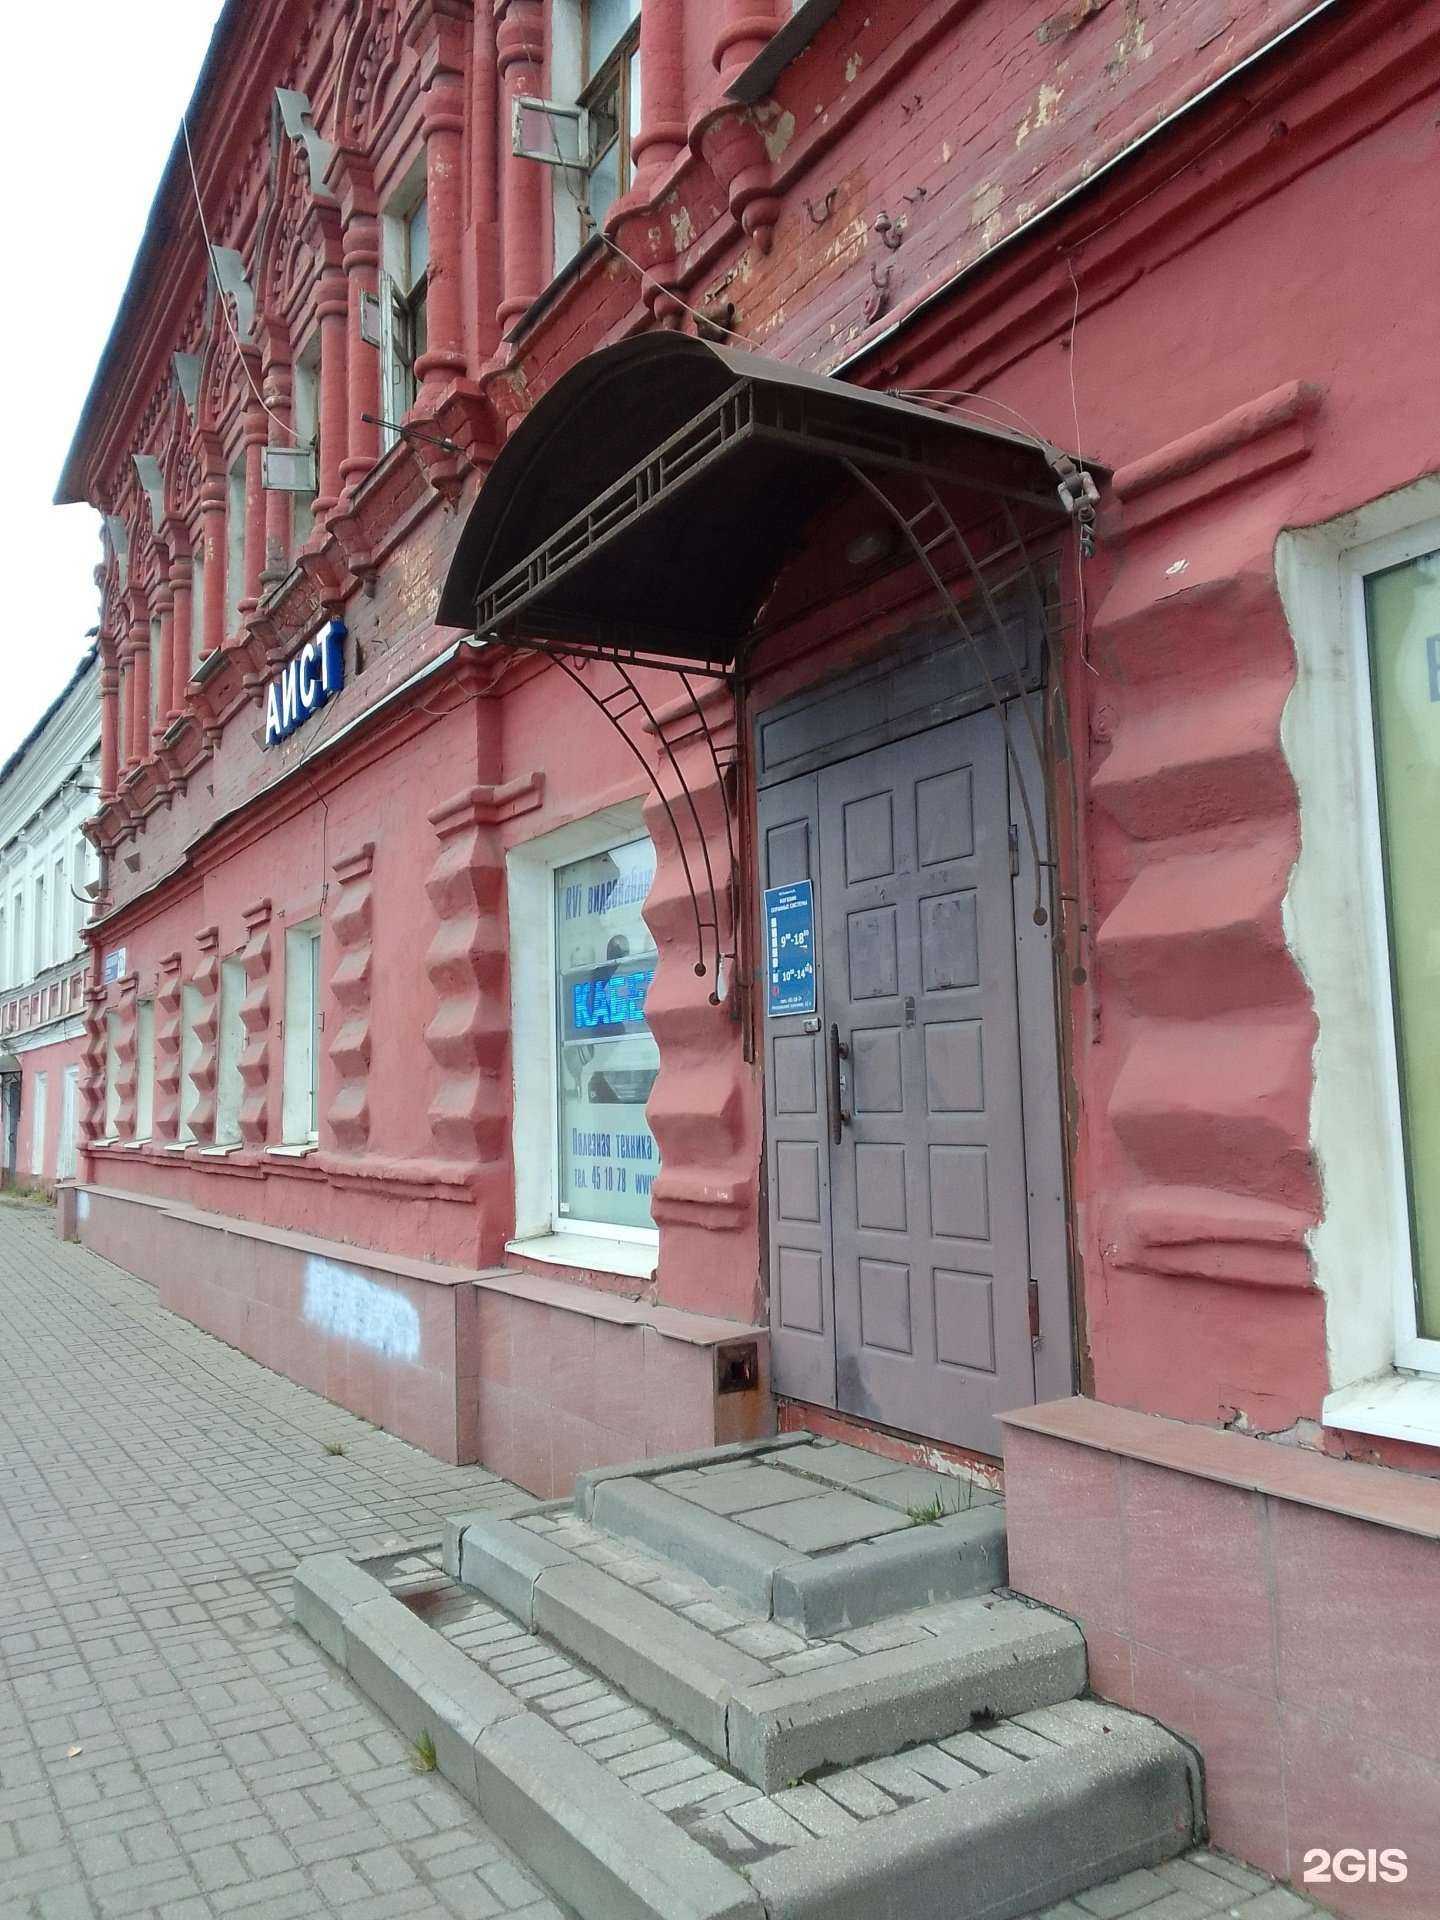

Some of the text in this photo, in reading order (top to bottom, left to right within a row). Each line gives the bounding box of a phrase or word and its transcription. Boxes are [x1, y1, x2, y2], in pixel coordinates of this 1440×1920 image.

[265, 620, 334, 745] АИСТ
[574, 970, 654, 1028] КАБЕ
[572, 1128, 653, 1160] Полезная техника
[592, 1166, 600, 1190] 45
[604, 1166, 613, 1191] 10
[617, 1167, 626, 1193] 78
